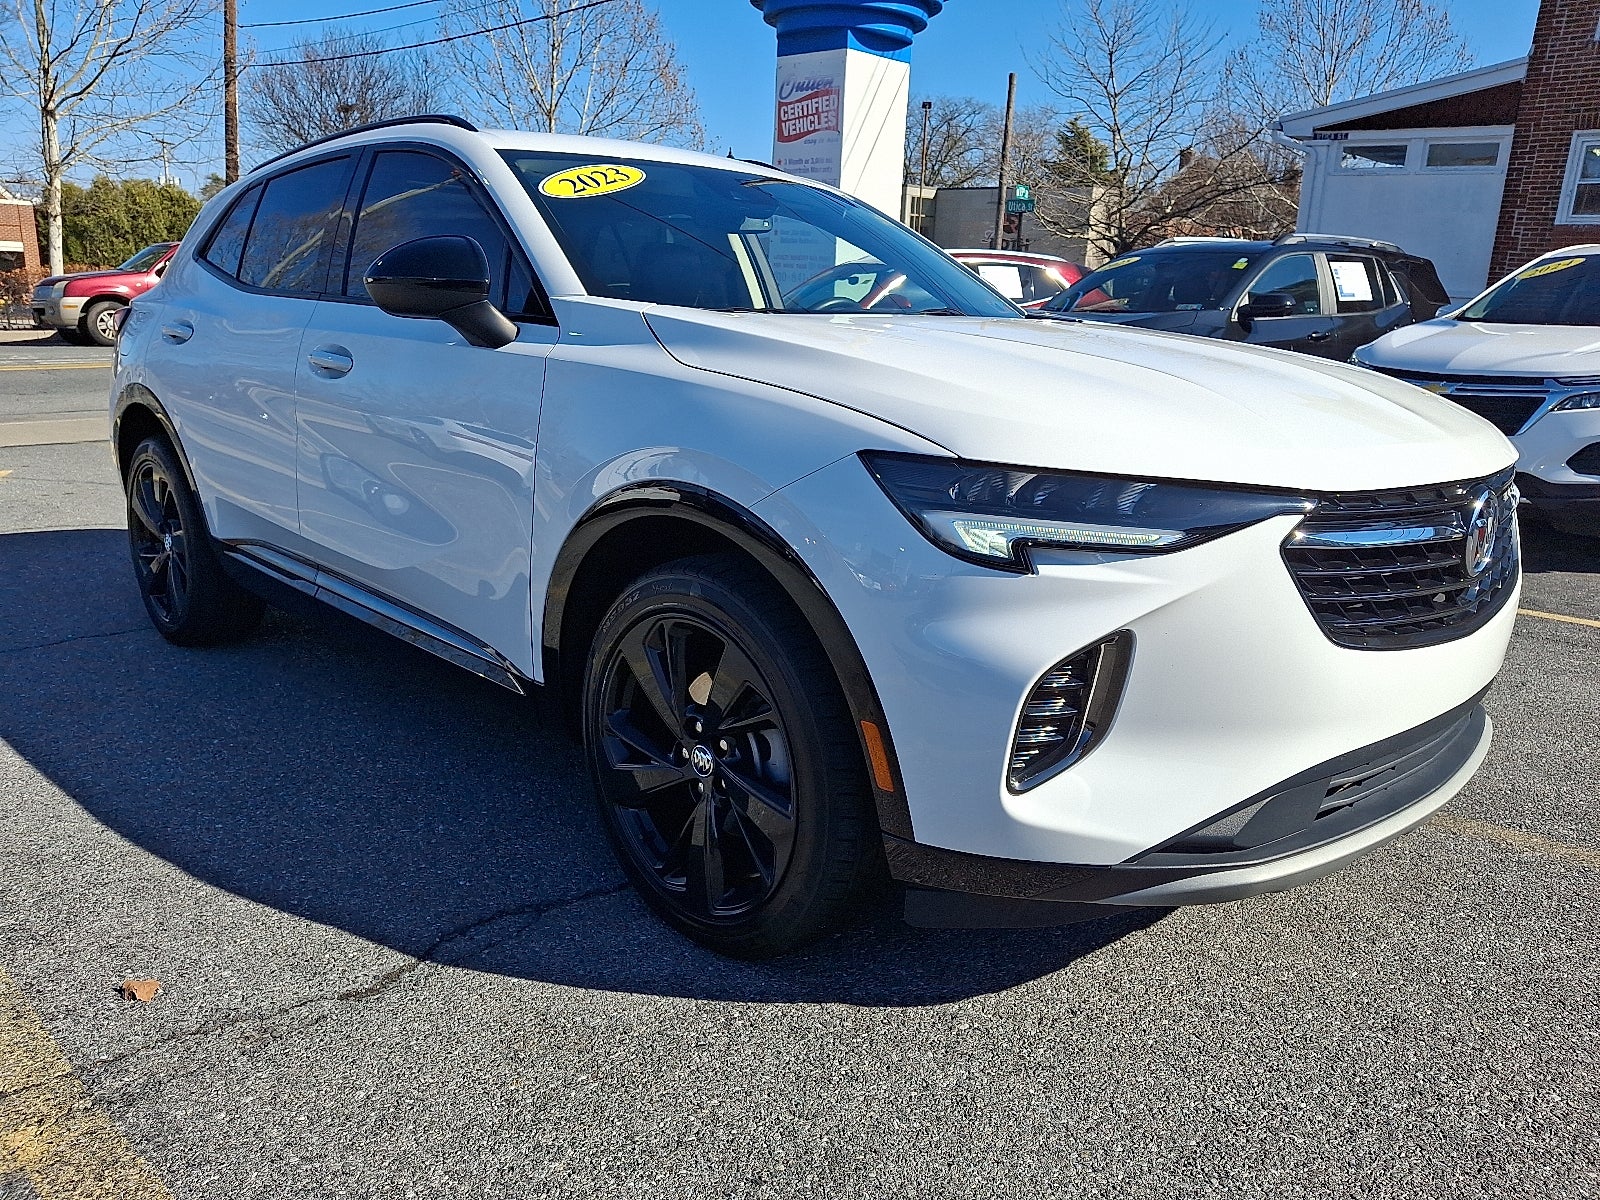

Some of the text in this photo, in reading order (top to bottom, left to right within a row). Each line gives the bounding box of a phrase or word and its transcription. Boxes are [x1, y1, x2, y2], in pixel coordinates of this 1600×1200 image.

[781, 95, 837, 121] CERTIFIED
[782, 110, 837, 136] VEHICLES
[559, 167, 630, 194] 2023
[1008, 201, 1026, 211] Utica
